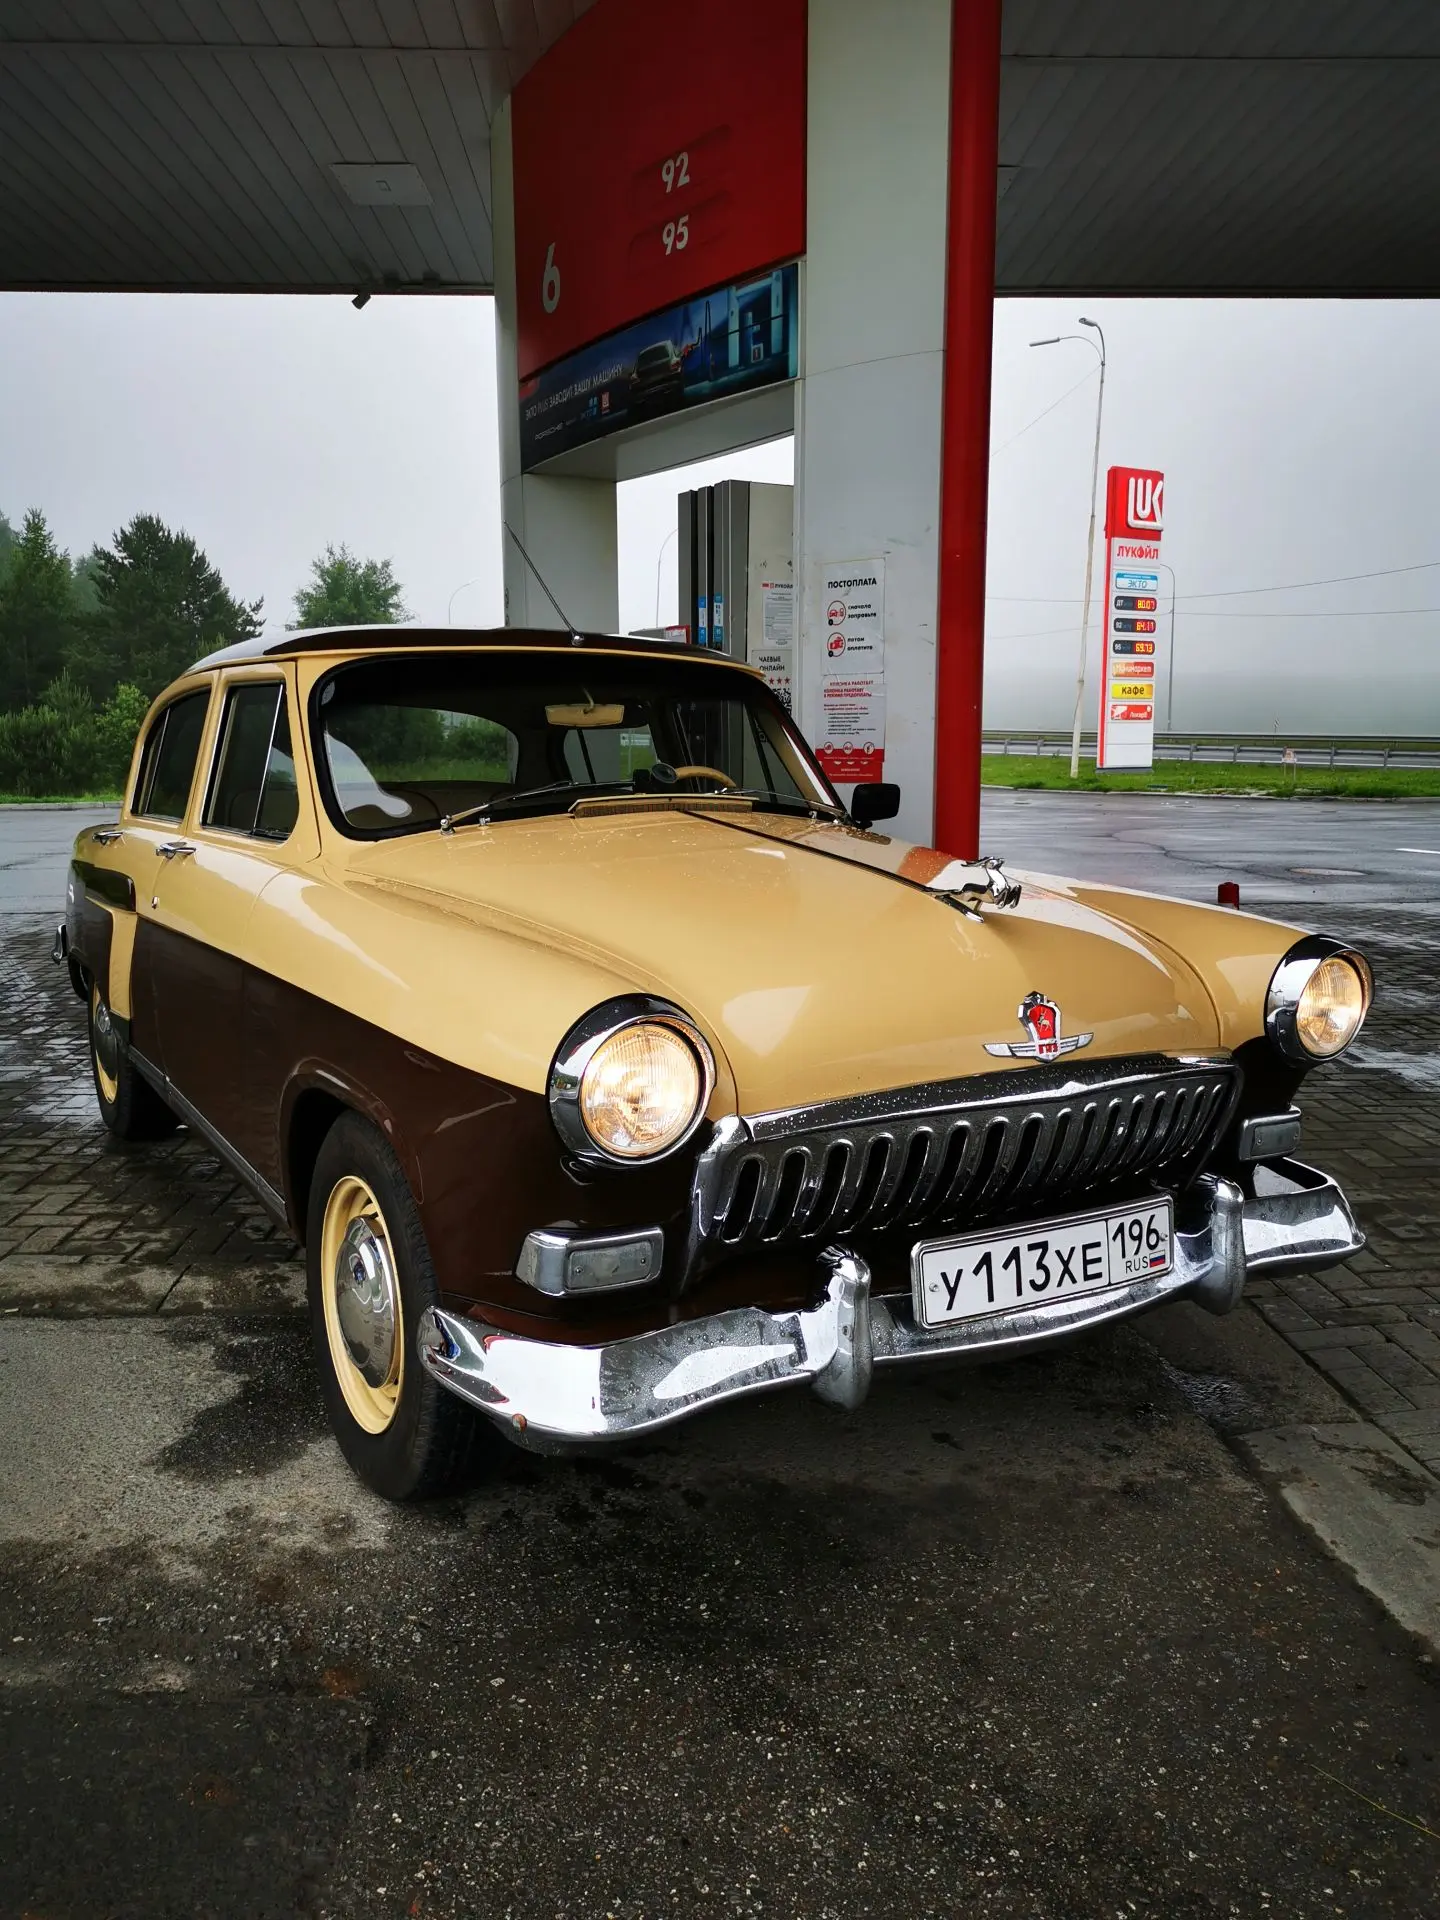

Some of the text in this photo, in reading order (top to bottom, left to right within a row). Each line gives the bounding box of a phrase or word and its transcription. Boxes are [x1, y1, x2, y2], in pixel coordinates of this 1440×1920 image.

[661, 151, 690, 193] 92
[662, 215, 689, 255] 95
[542, 241, 561, 314] 6
[549, 385, 573, 408] ЗАВОДИТ
[574, 376, 591, 395] ВАШУ
[592, 363, 623, 387] МАШИНУ
[1116, 544, 1159, 560] ЛУКОЙЛ
[827, 577, 878, 589] ПОСТОПЛАТА
[1127, 579, 1148, 589] ЭКТО
[758, 655, 781, 663] ЧАЕВЫЕ
[759, 664, 785, 672] ОНЛАЙН
[1121, 685, 1145, 696] кафе
[1111, 1214, 1160, 1259] 196
[1125, 1255, 1149, 1274] RUS
